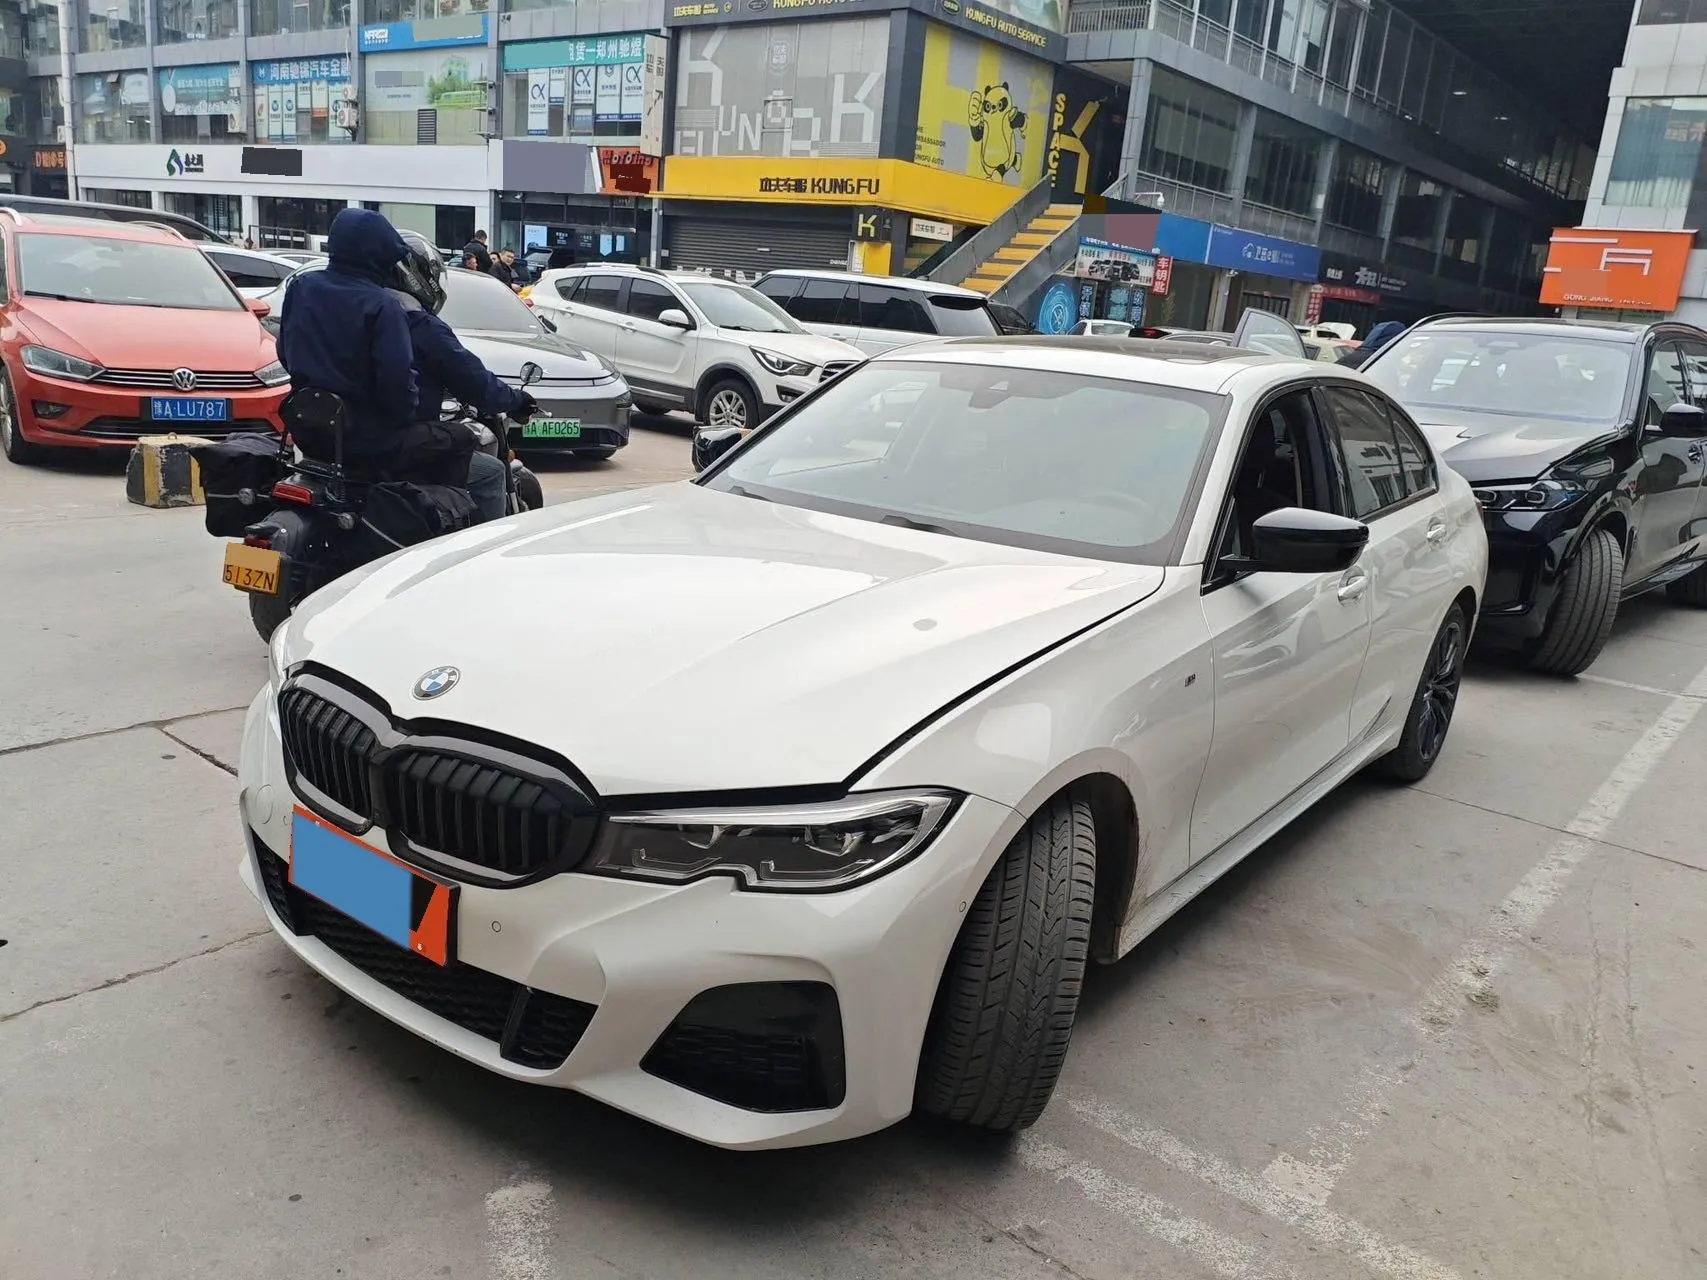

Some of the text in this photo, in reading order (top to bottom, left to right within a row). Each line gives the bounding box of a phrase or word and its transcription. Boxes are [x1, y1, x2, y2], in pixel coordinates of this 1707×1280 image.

[965, 6, 997, 27] KUNGFU
[997, 20, 1018, 36] AUTO
[1017, 29, 1047, 48] SERVICE
[811, 177, 881, 195] KUNGFU
[1153, 257, 1170, 293] 车钥匙
[541, 421, 580, 436] AF0265
[224, 563, 276, 591] 513ZN
